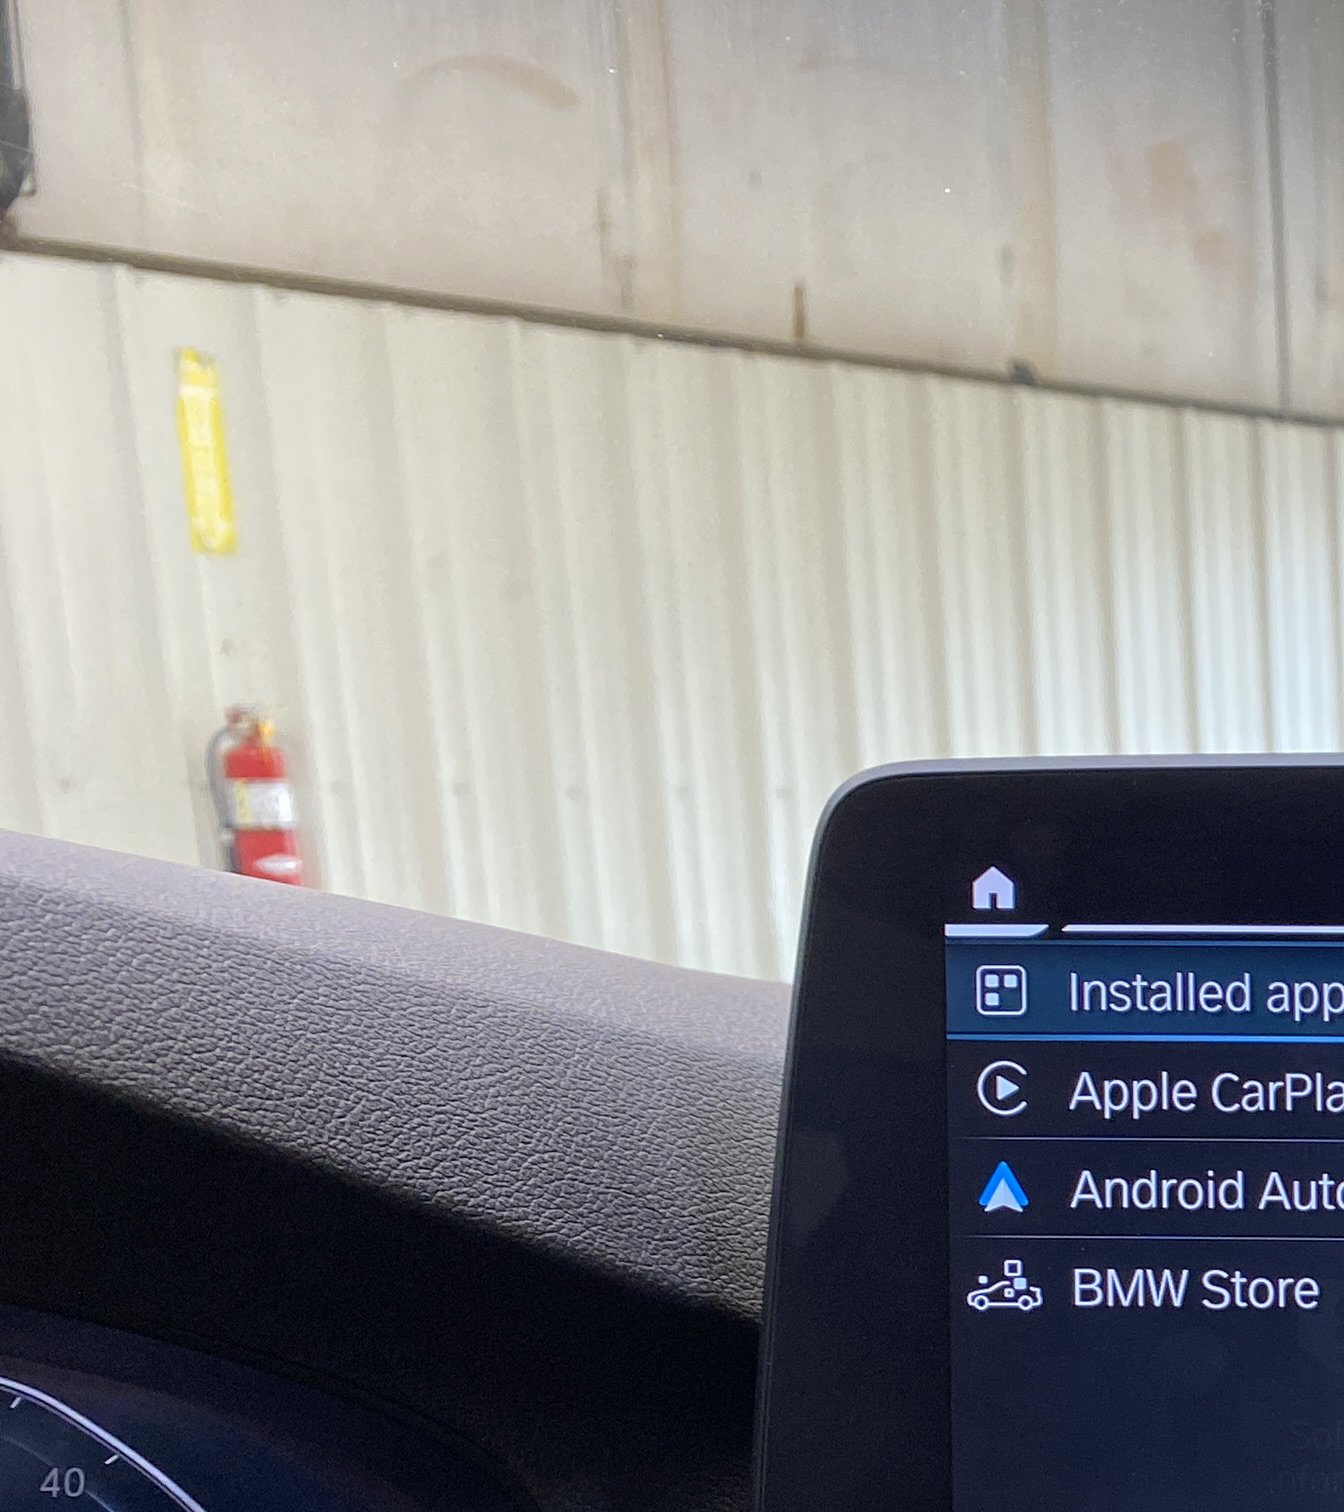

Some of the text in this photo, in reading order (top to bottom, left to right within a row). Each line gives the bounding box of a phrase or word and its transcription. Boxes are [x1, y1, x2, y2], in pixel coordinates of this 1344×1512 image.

[1070, 972, 1251, 1013] Installed
[1069, 1070, 1198, 1118] Apple
[1069, 1169, 1244, 1210] Android
[1073, 1268, 1320, 1310] BMW Store
[38, 1464, 88, 1502] 40
